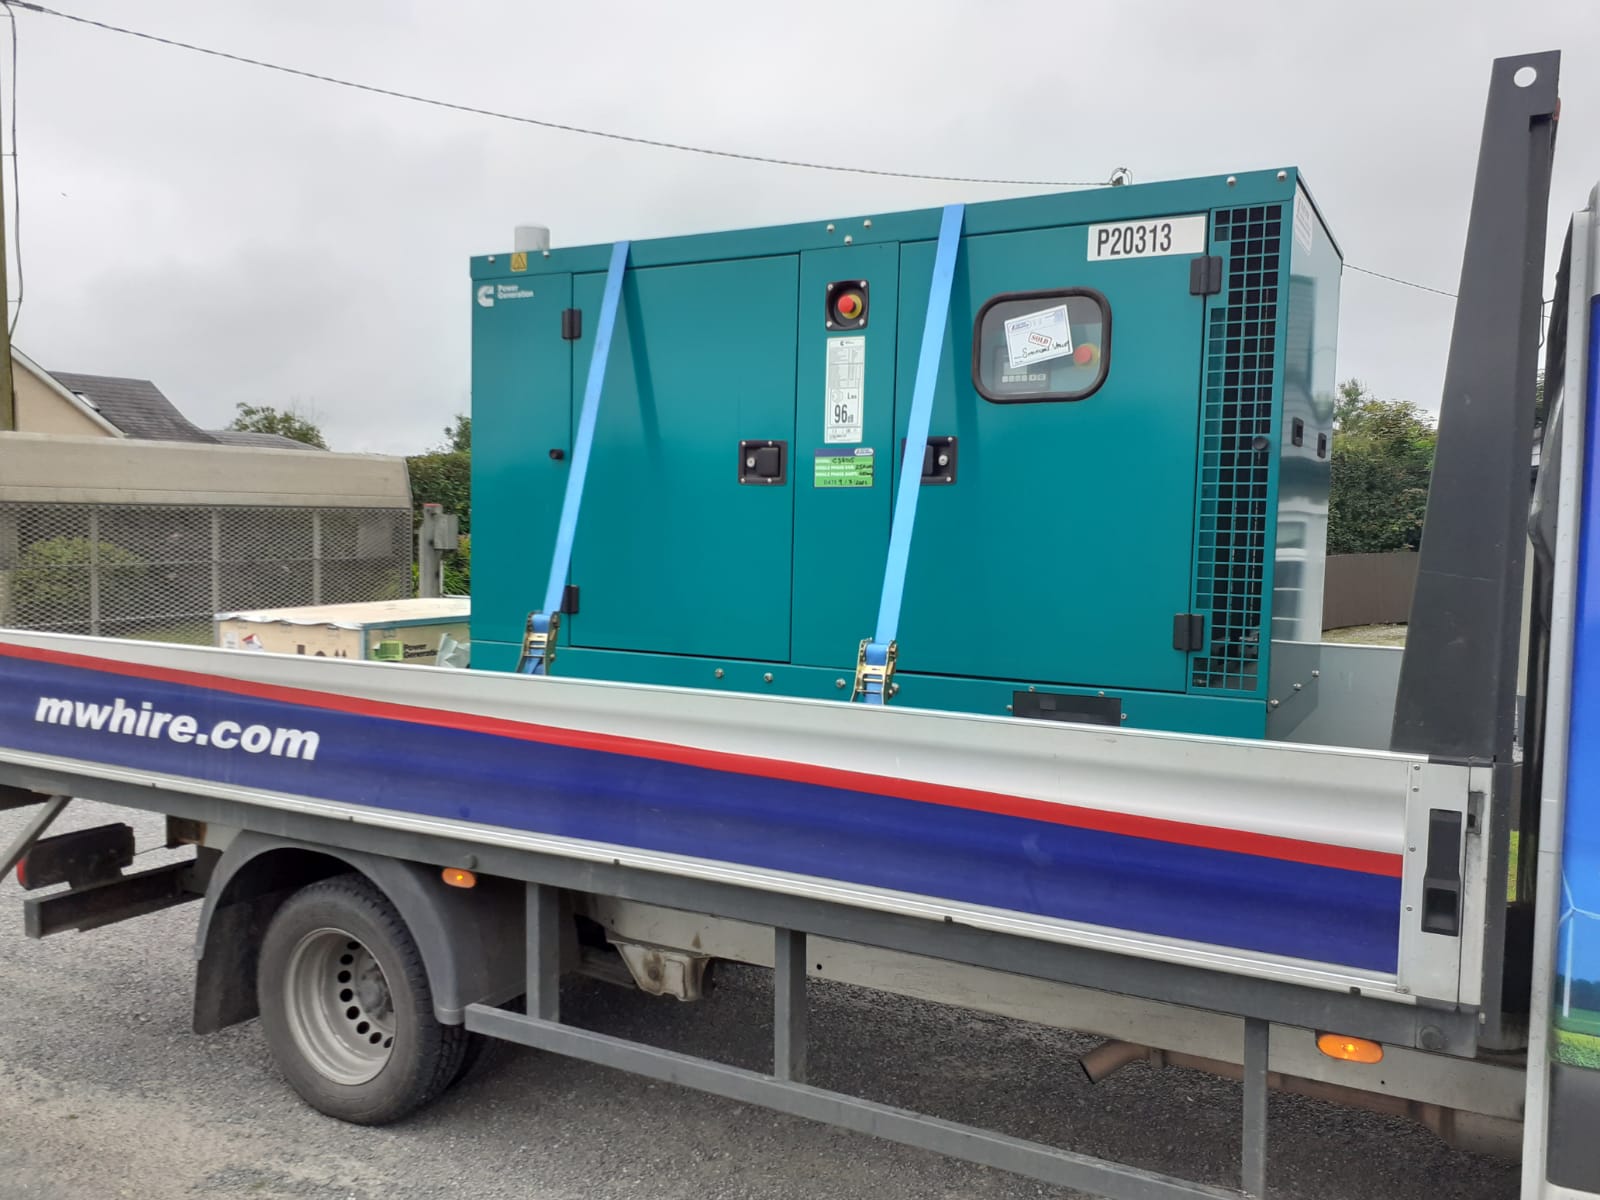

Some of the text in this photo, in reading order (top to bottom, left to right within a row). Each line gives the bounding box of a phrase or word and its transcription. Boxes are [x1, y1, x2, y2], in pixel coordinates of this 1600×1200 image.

[1097, 223, 1171, 256] P20313
[1030, 334, 1050, 345] SOLD
[834, 404, 848, 423] 96
[35, 697, 320, 761] mwhire.com
